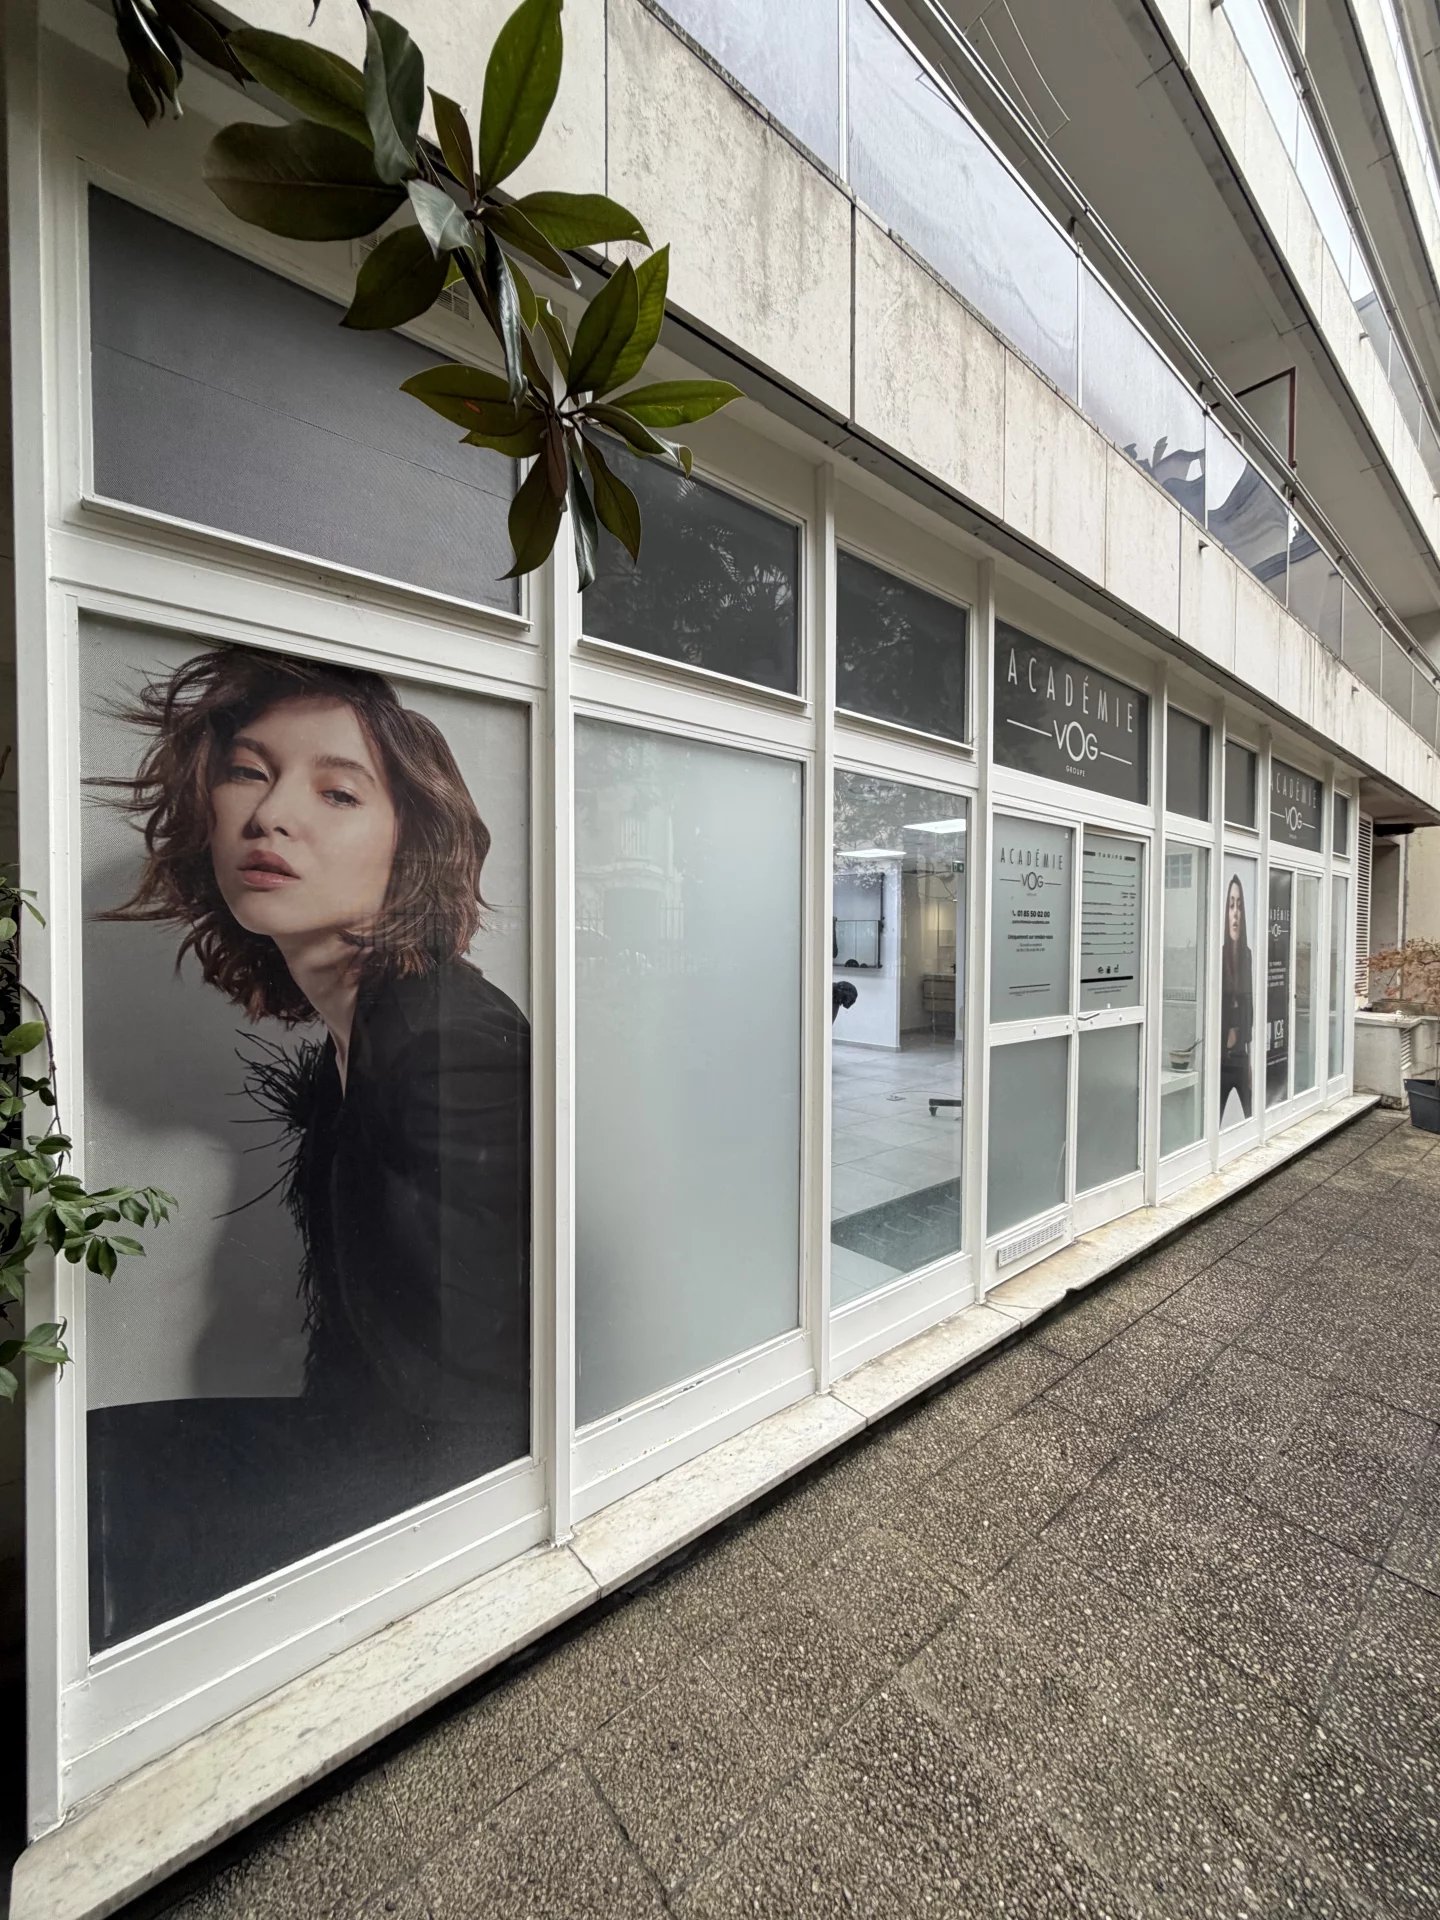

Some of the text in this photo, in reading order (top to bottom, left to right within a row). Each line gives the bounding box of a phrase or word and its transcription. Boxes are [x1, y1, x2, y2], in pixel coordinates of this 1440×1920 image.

[1007, 647, 1133, 733] ACADÉMIE
[1053, 719, 1099, 762] VOG
[1065, 764, 1086, 778] GROUPE
[1284, 806, 1303, 831] VOG
[1000, 847, 1063, 870] ACADÉMIE
[1021, 871, 1044, 890] VOG
